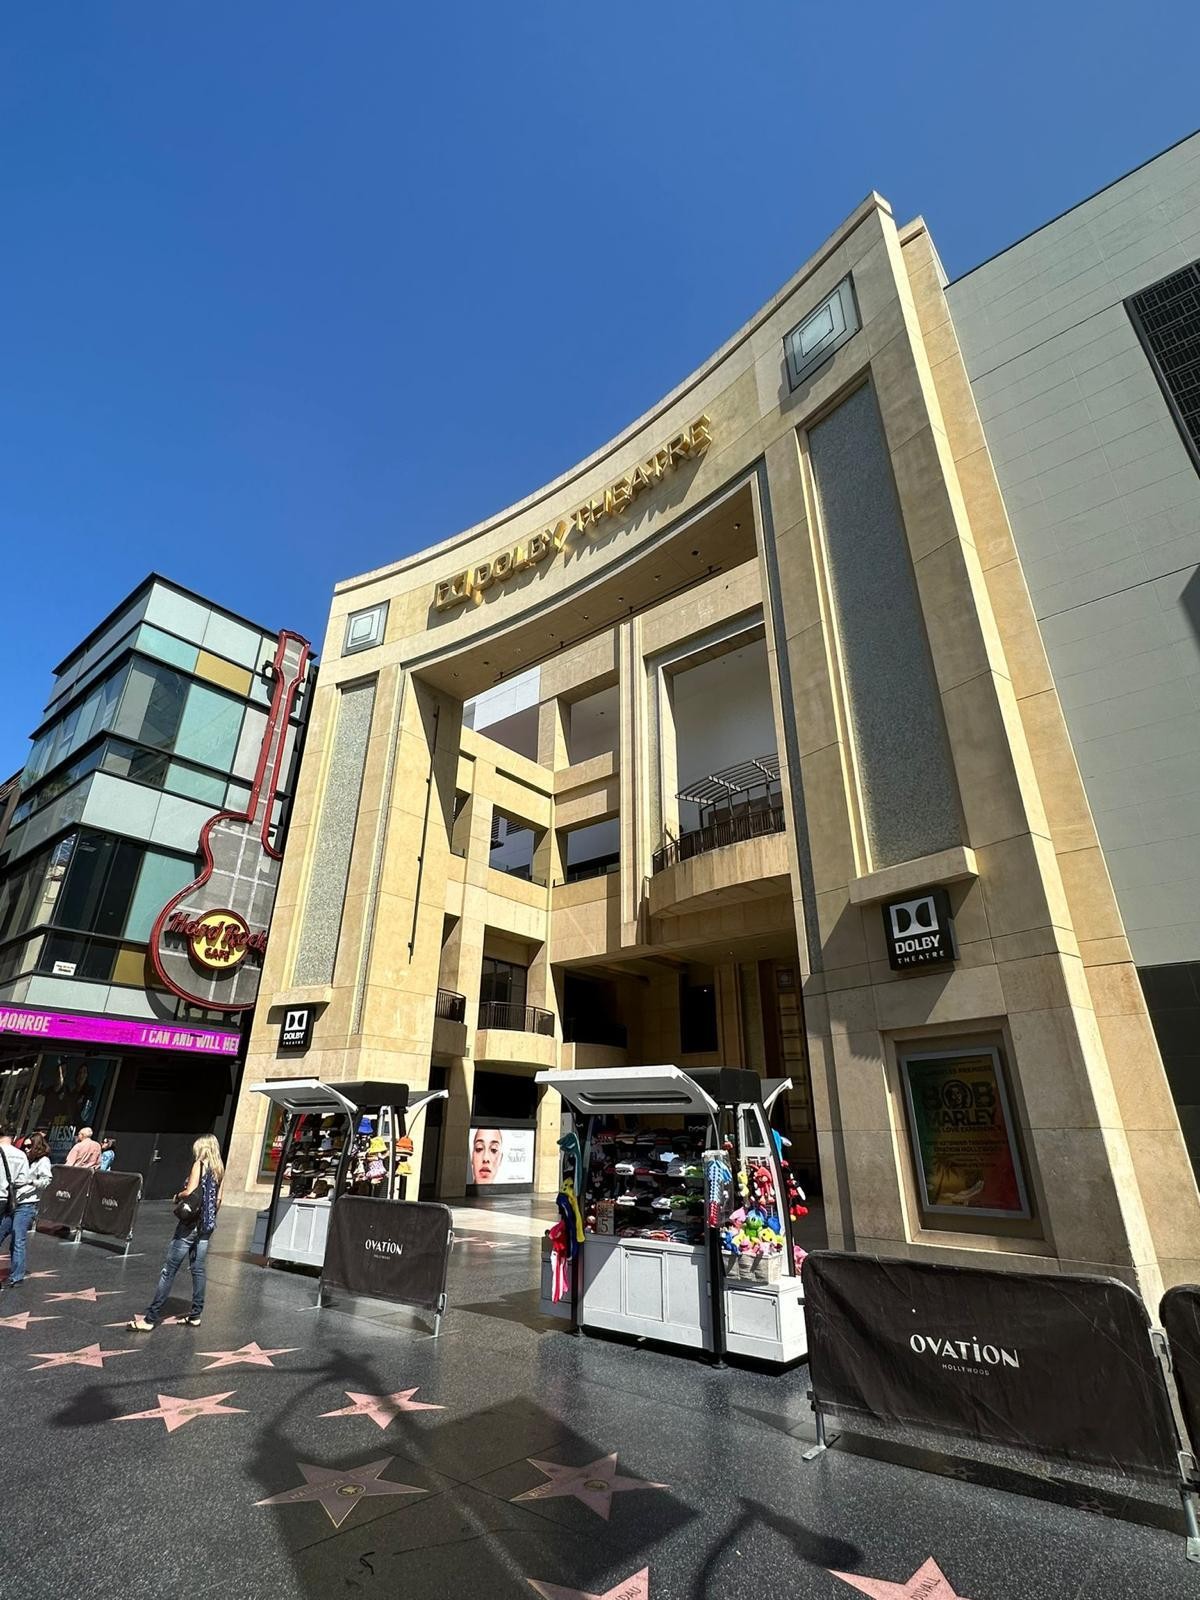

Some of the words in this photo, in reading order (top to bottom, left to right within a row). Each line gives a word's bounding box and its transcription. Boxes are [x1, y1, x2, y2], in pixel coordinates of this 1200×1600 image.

[471, 521, 566, 592] DOLBY
[571, 414, 713, 533] THEATRE
[169, 912, 225, 940] Hard
[894, 934, 940, 955] DOLBY
[897, 950, 944, 964] THEATRE
[0, 1011, 52, 1033] MONROE
[141, 1029, 147, 1042] I
[148, 1029, 170, 1045] CAN
[171, 1032, 193, 1047] AND
[196, 1034, 220, 1050] WILL
[283, 1032, 304, 1040] DOLBY
[922, 1080, 997, 1110] BOB
[926, 1109, 997, 1127] MARLEY
[942, 1363, 990, 1376] HOLLYWOOD
